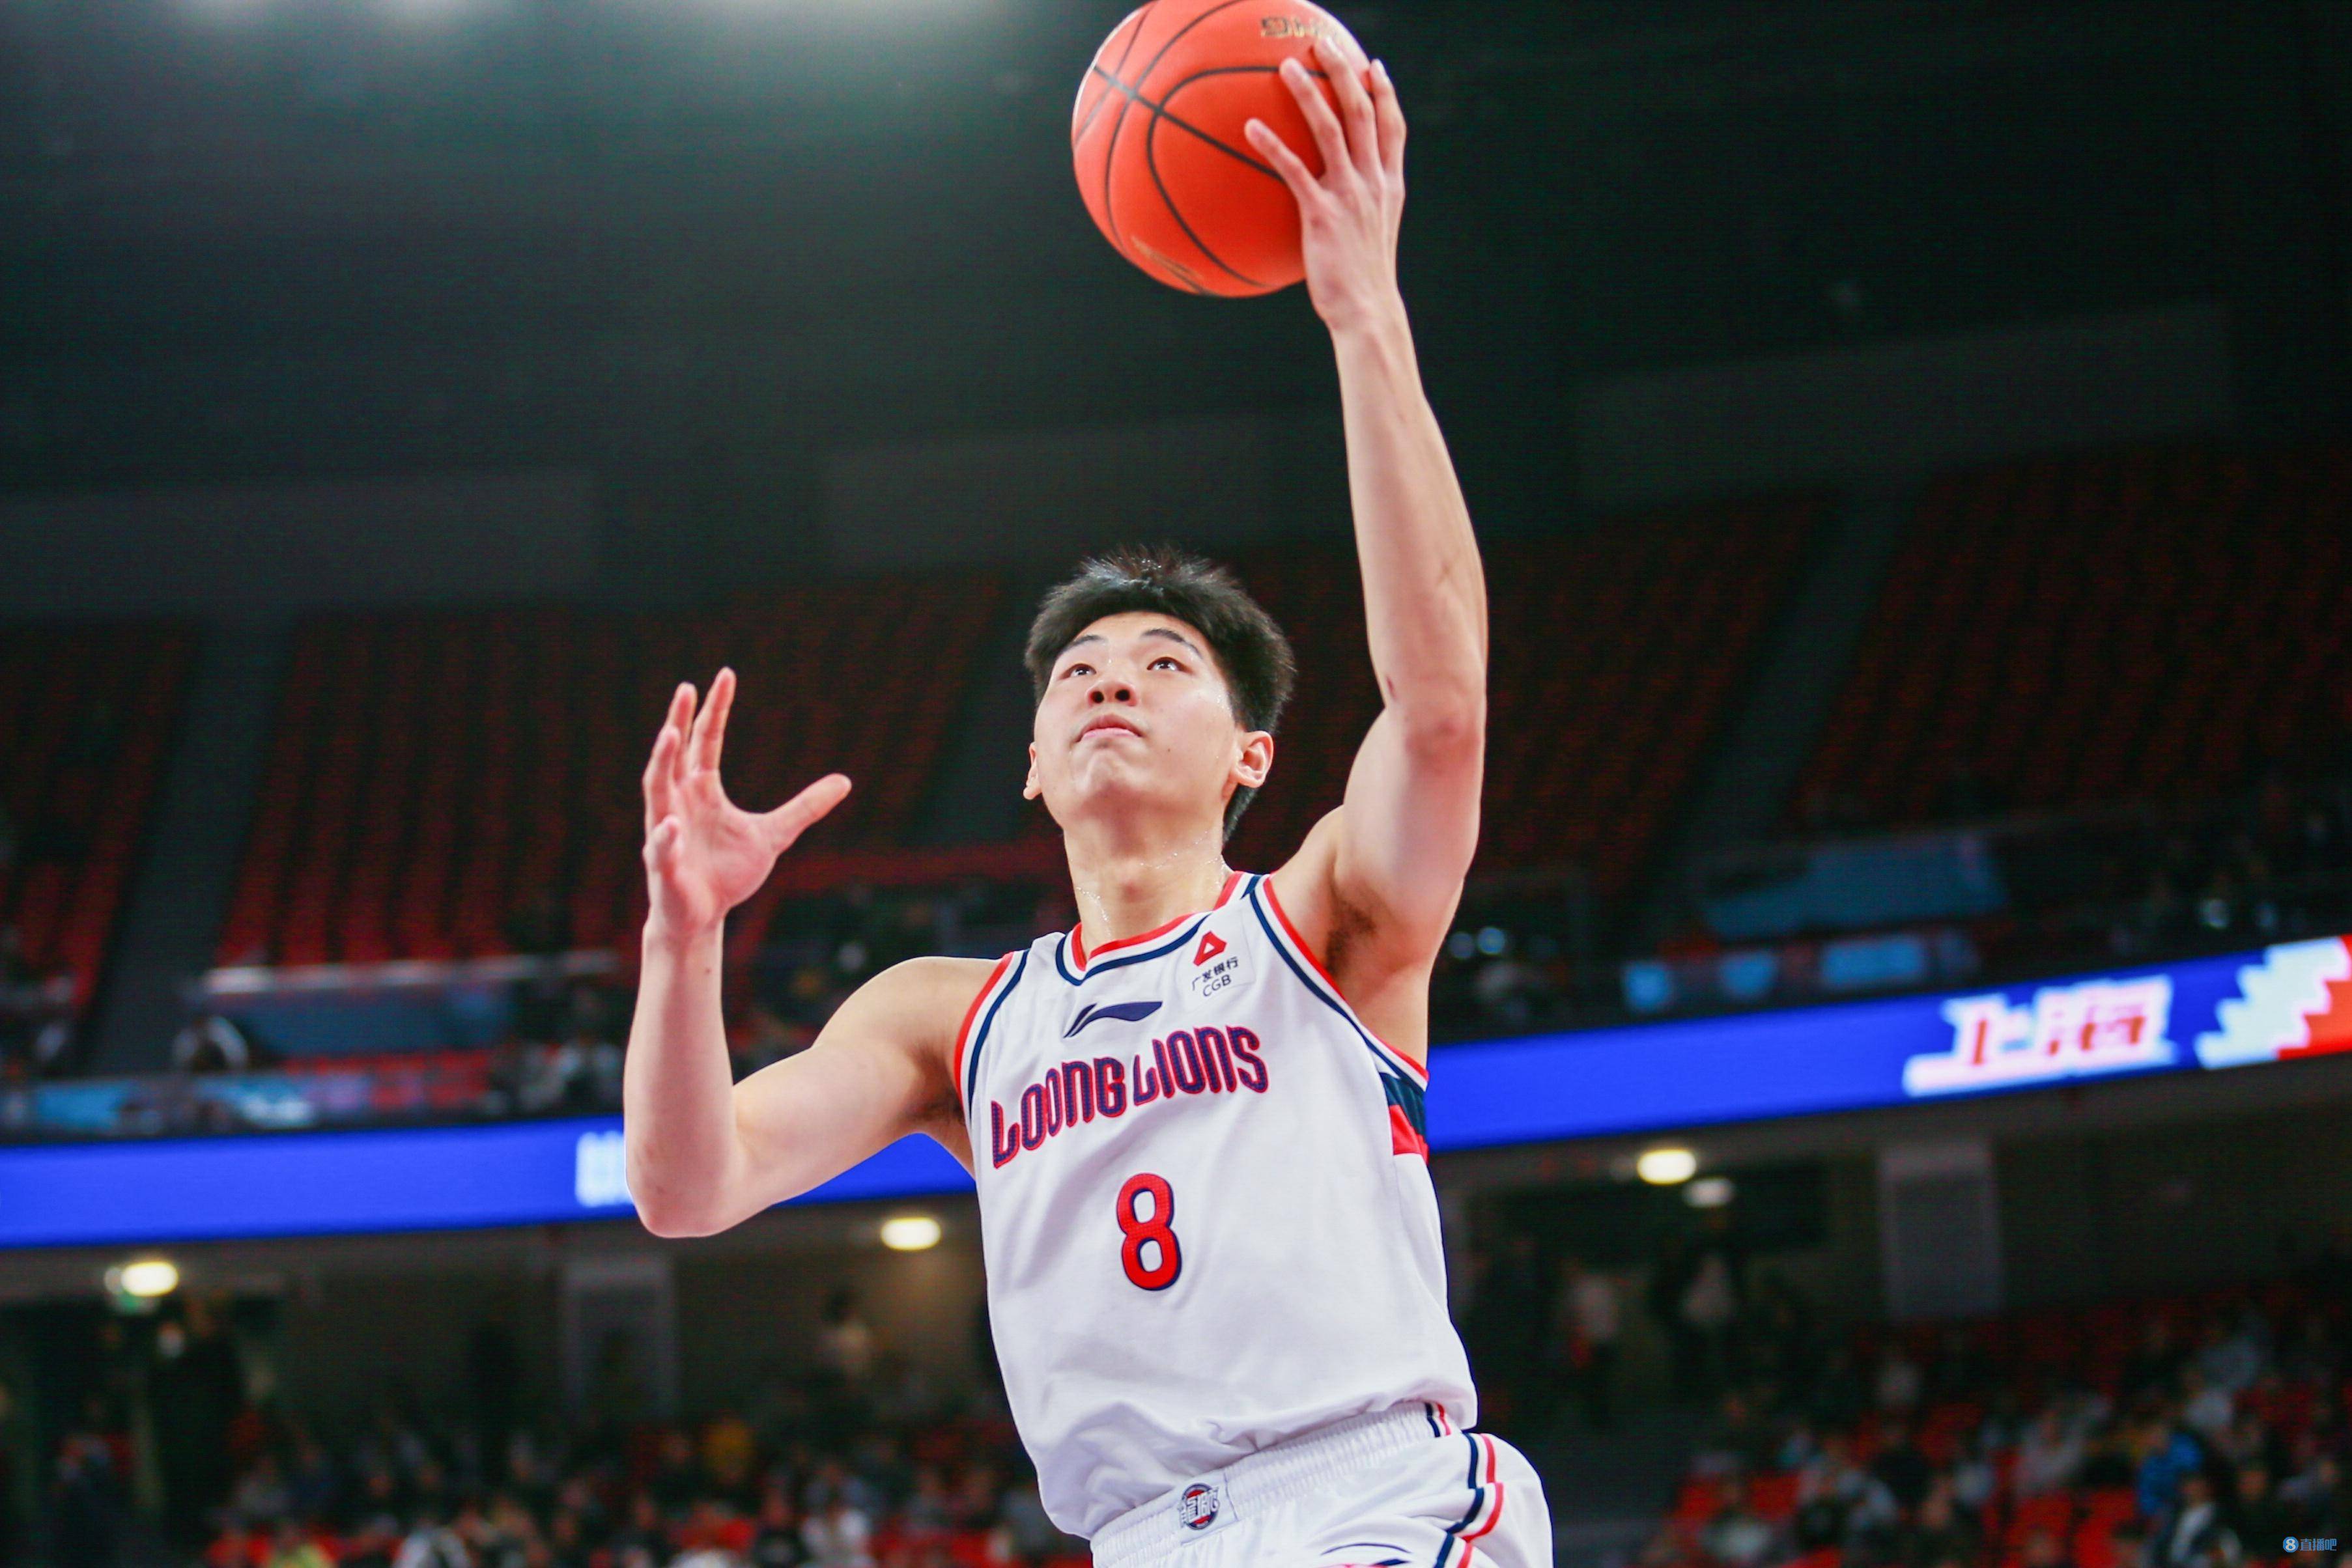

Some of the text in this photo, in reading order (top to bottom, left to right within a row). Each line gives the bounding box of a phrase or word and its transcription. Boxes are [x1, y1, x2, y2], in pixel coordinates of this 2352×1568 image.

[1192, 957, 1238, 991] 广发银行
[1202, 974, 1231, 996] CGB
[991, 1025, 1269, 1169] LOONG LIONS
[1116, 1173, 1182, 1291] 8
